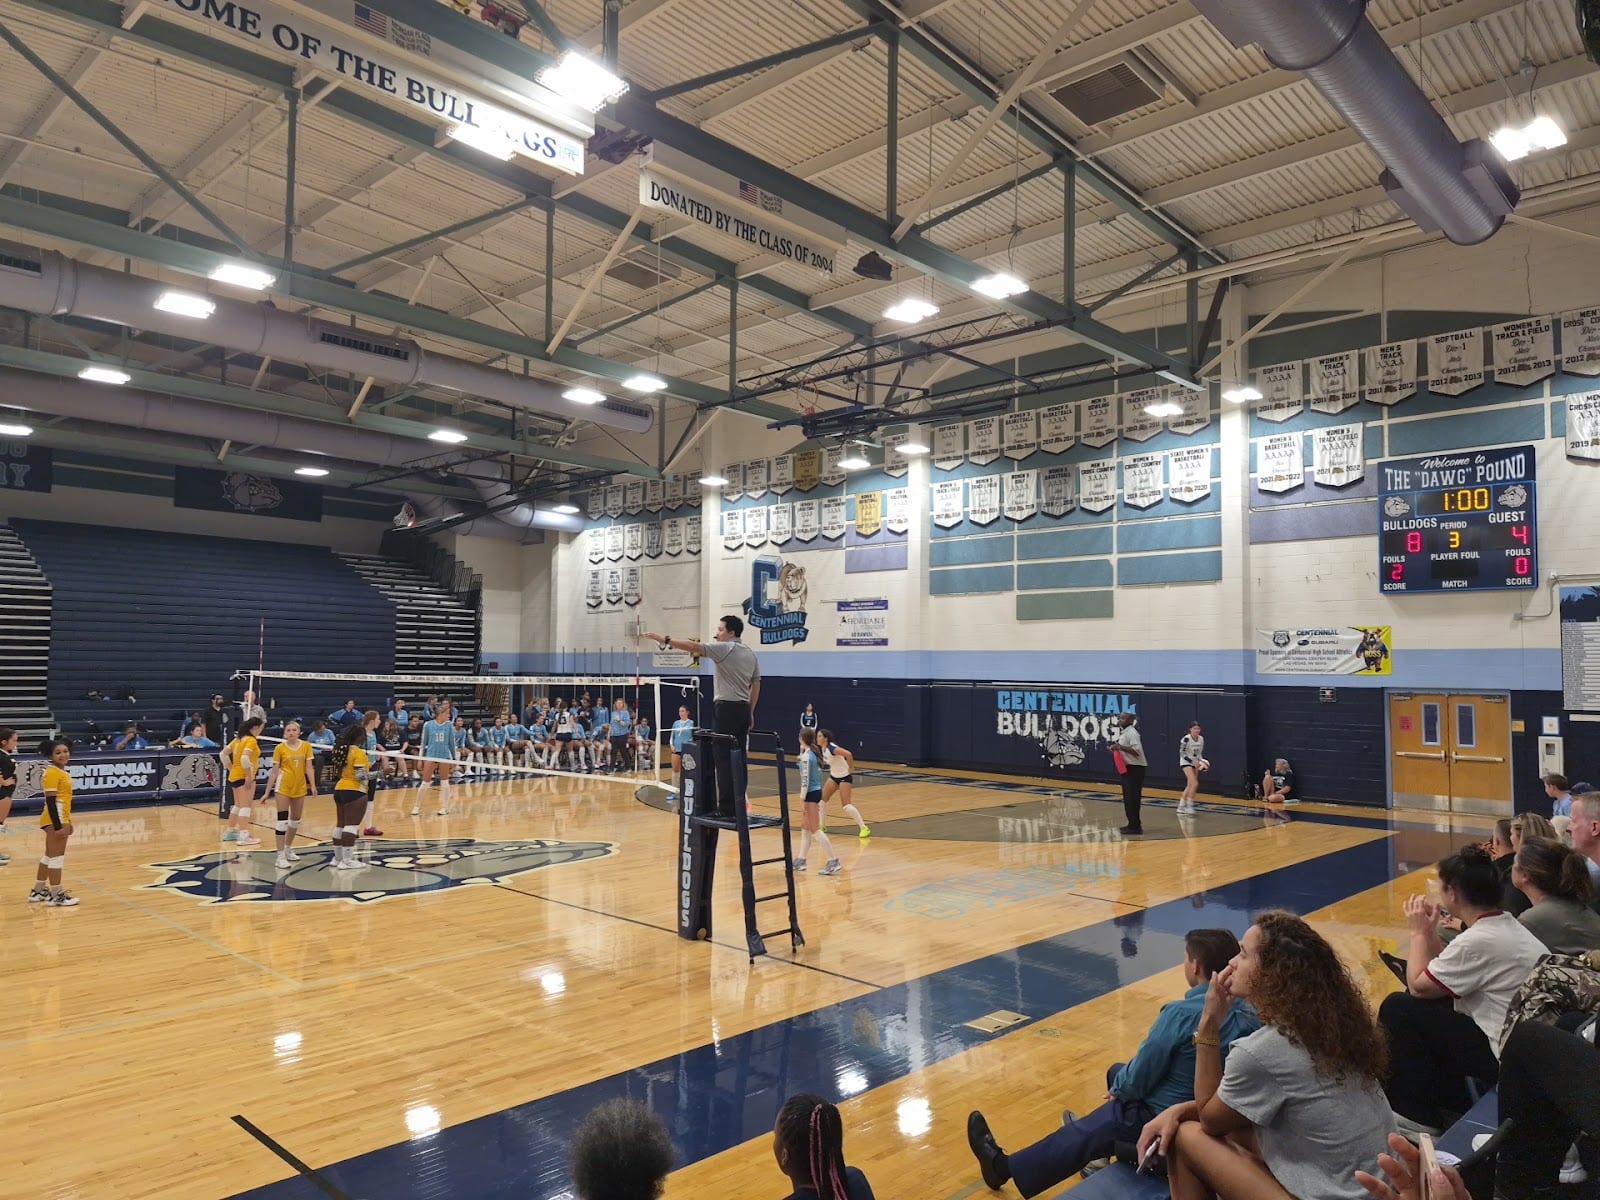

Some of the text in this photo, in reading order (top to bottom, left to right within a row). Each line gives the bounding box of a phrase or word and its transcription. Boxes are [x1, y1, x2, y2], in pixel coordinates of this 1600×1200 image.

[272, 24, 321, 59] OF
[331, 46, 397, 93] THE
[406, 77, 557, 158] BULLGS
[650, 181, 834, 274] DONATED BY THE CLASS OF 2004
[1435, 331, 1475, 344] SOFTBALL
[1496, 331, 1520, 341] TRACK
[1528, 325, 1550, 335] FIELD
[1380, 352, 1402, 360] TRACK
[1262, 364, 1296, 375] SOFTBALL
[1324, 362, 1345, 371] TRACK
[1497, 360, 1552, 375] 2012 2013
[1430, 372, 1482, 387] 2012 2013
[1420, 454, 1486, 469] Welcome to
[1384, 467, 1411, 491] THE
[1476, 453, 1526, 483] POUND
[1443, 487, 1490, 511] 1:00
[1383, 517, 1438, 531] BULLDOGS
[1488, 511, 1526, 524] GUEST
[1440, 521, 1467, 530] PERIOD
[1407, 531, 1422, 553] 8
[1449, 531, 1460, 548] 3
[1511, 525, 1528, 545] 4
[1383, 555, 1406, 564] FOULS
[1430, 551, 1480, 561] PLAYER FOUL
[1505, 549, 1531, 557] FOULS
[1391, 563, 1404, 581] 2
[1515, 557, 1529, 575] 0
[1383, 582, 1406, 591] SCORE
[1442, 579, 1468, 588] MATCH
[1506, 577, 1532, 586] SCORE
[750, 612, 804, 628] CENTENNIAL
[762, 628, 806, 643] BULLDOGS
[997, 690, 1137, 715] CENTENNIAL
[997, 710, 1137, 742] BULLDOG
[682, 778, 695, 928] BULLDOGS
